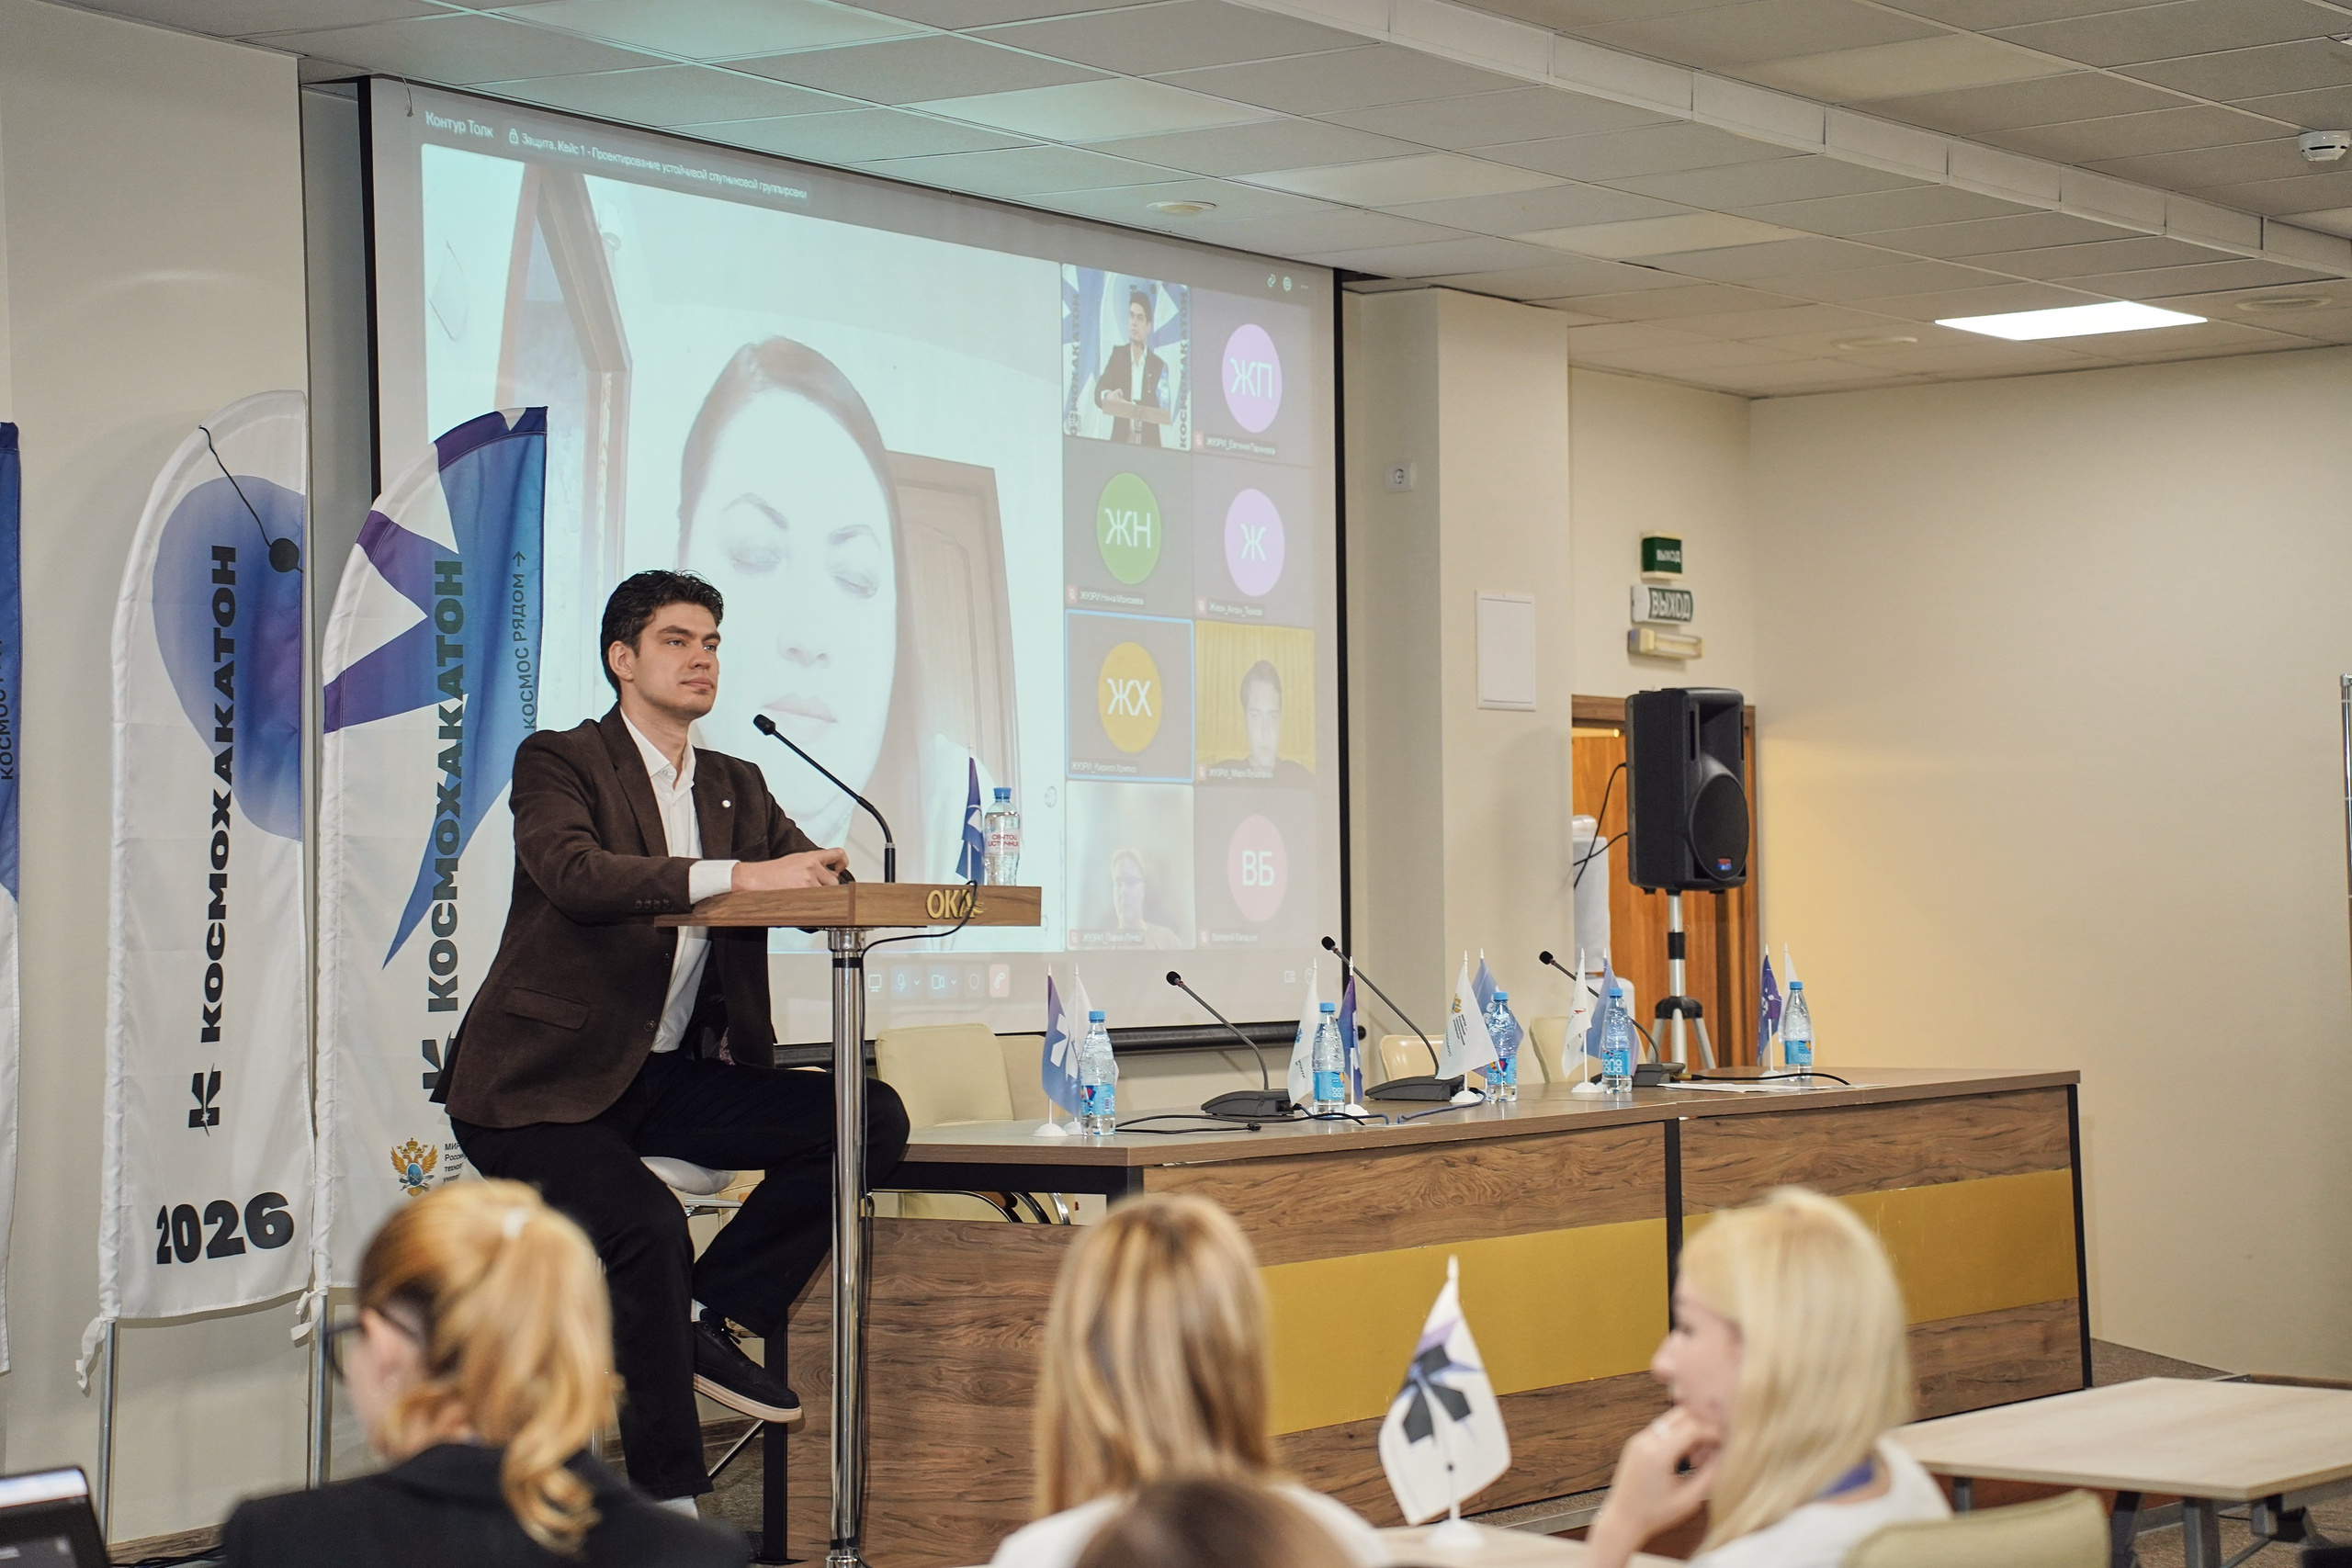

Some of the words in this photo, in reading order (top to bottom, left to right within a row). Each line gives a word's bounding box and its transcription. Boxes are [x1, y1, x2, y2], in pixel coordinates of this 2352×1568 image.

[424, 110, 466, 134] Контур
[468, 119, 493, 138] Толк
[521, 132, 556, 150] Защита.
[558, 140, 579, 155] Кейс
[581, 144, 585, 155] 1
[592, 147, 661, 172] Проектирование
[662, 162, 707, 180] устойчивой
[708, 171, 758, 189] спутниковой
[759, 181, 808, 199] группировки
[1229, 356, 1272, 399] ЖП
[1104, 507, 1152, 549] ЖН
[1240, 523, 1267, 561] Ж
[1657, 549, 1680, 563] ВЫХОД
[512, 573, 527, 642] РЯДОМ
[1651, 591, 1690, 620] ВЫХОД
[514, 646, 536, 730] КОСМОС
[1106, 678, 1153, 717] ЖХ
[200, 545, 237, 1043] КОСМОХАКАТОН
[427, 559, 465, 1013] КОСМОХАКАТОН
[1241, 850, 1275, 886] ВБ
[445, 1142, 460, 1151] МИР
[155, 1191, 295, 1265] 2026
